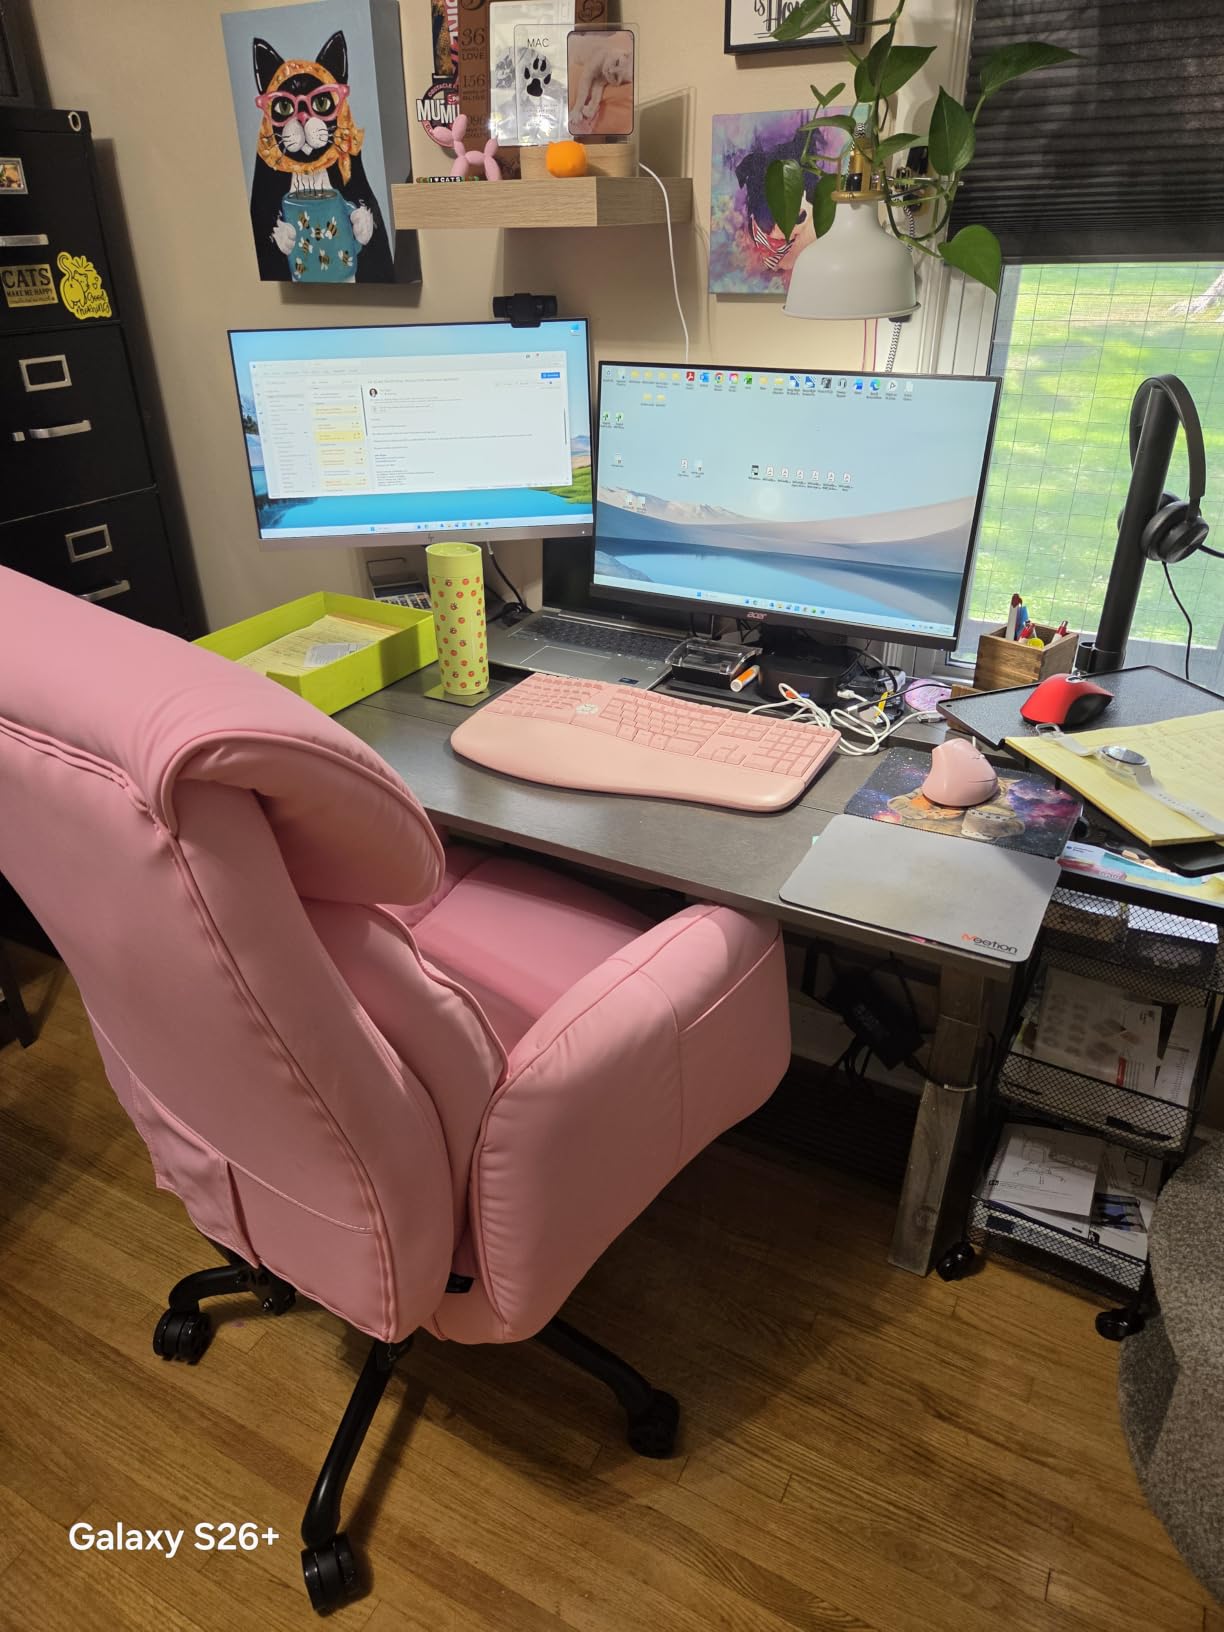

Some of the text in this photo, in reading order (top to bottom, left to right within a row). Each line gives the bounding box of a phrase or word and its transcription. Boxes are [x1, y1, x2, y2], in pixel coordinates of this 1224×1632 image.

[527, 38, 550, 48] MAC
[463, 74, 485, 89] 156
[1, 267, 51, 289] CATS
[7, 290, 23, 298] MAKE
[24, 289, 33, 297] ME
[747, 611, 767, 620] acer
